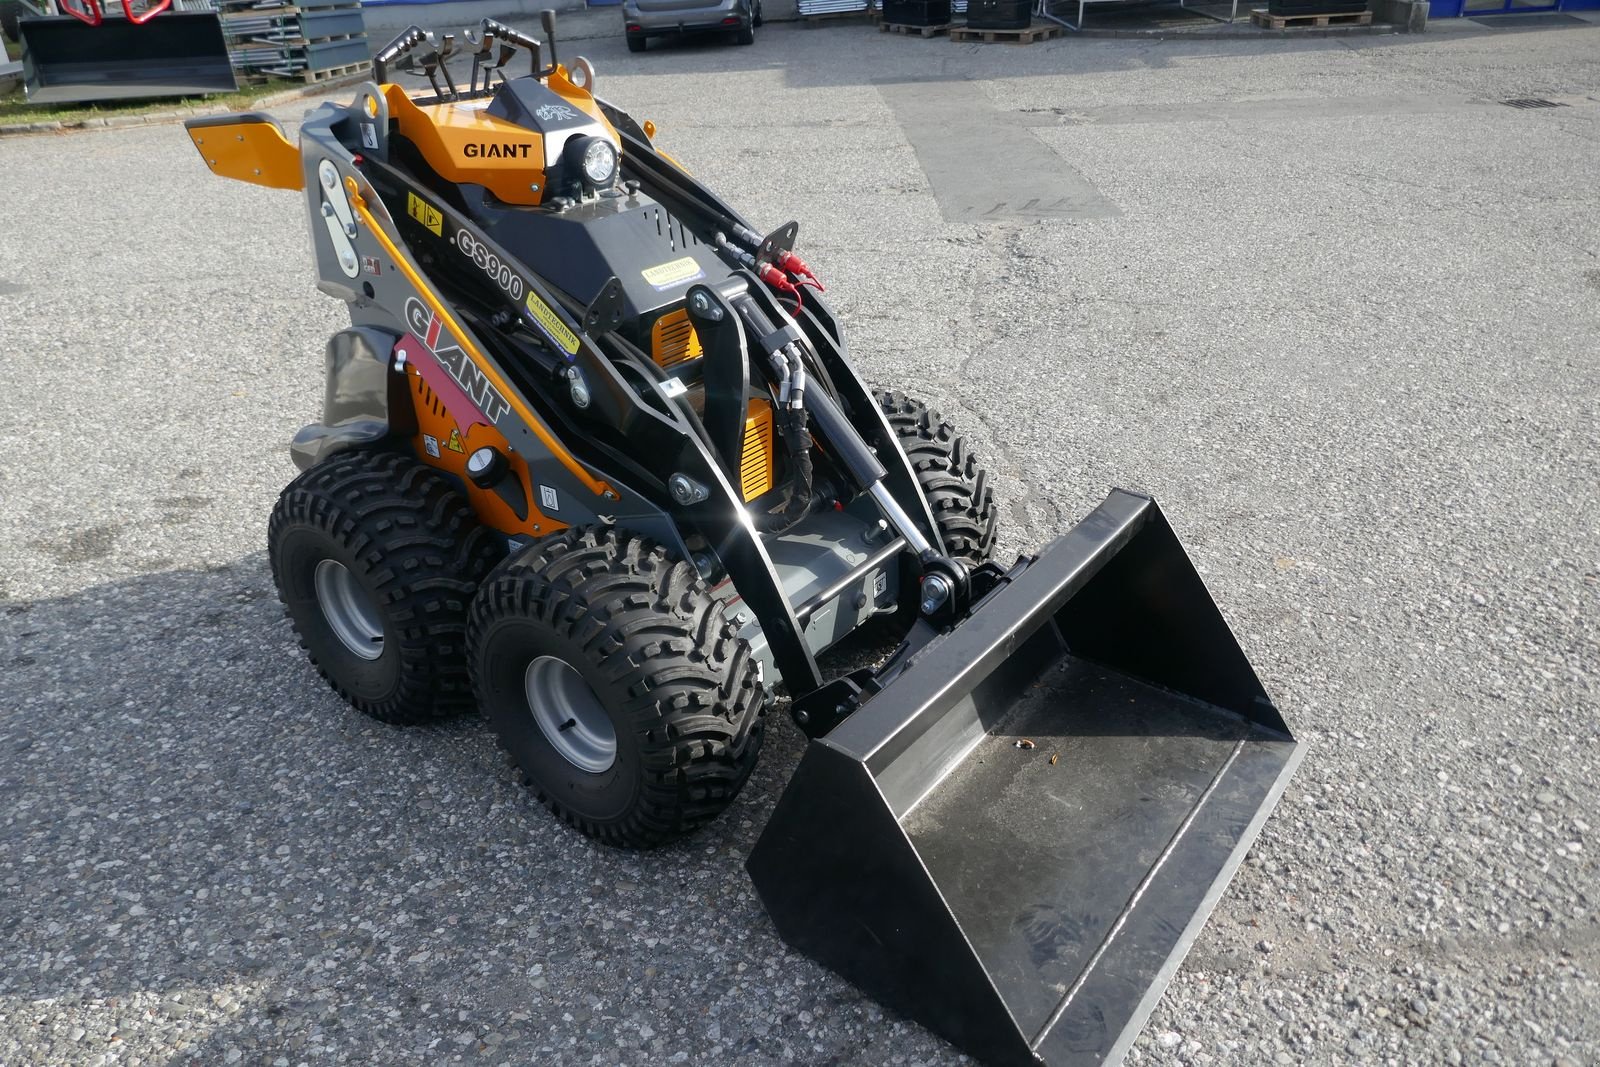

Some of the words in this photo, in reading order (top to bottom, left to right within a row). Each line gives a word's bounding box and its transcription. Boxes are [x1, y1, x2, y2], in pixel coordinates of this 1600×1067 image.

[463, 143, 532, 158] GIANT
[457, 228, 523, 300] GS900
[530, 294, 576, 346] LANDTECHNIK
